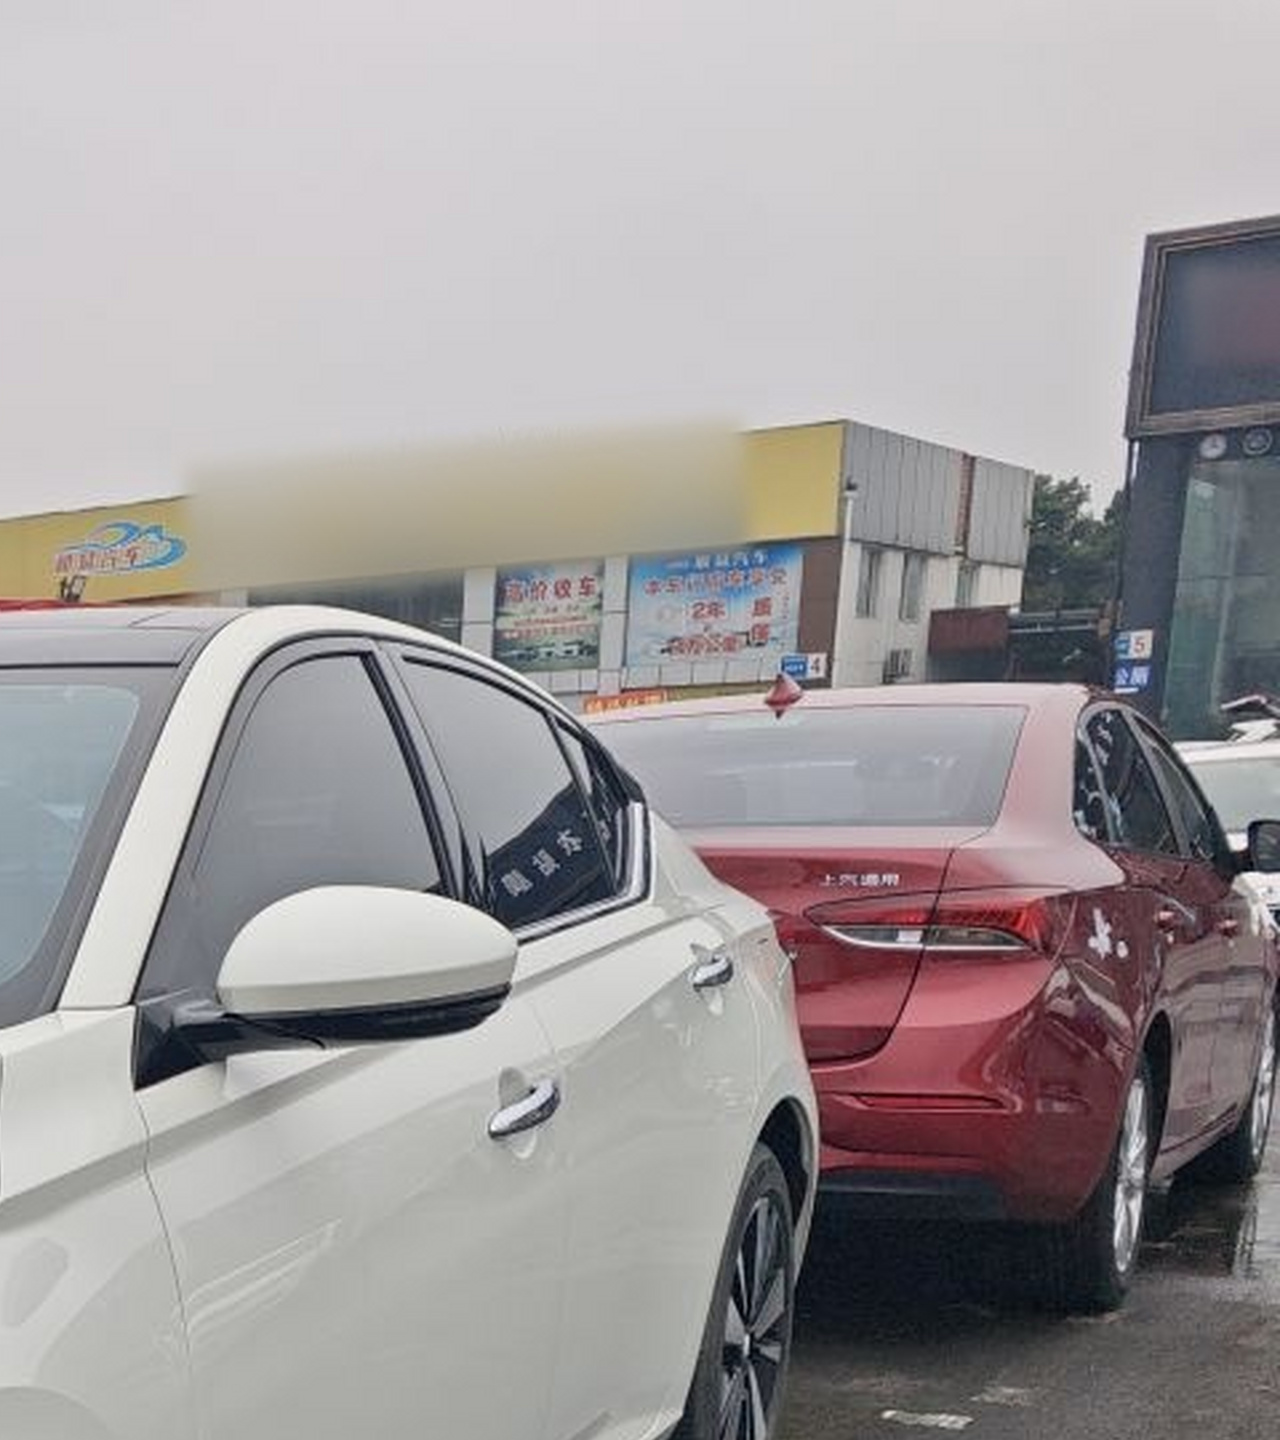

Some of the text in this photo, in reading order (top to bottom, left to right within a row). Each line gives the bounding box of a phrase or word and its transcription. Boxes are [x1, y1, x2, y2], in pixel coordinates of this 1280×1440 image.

[505, 575, 596, 603] 高价收车
[810, 656, 822, 675] 4
[819, 873, 900, 887] 上汽通用
